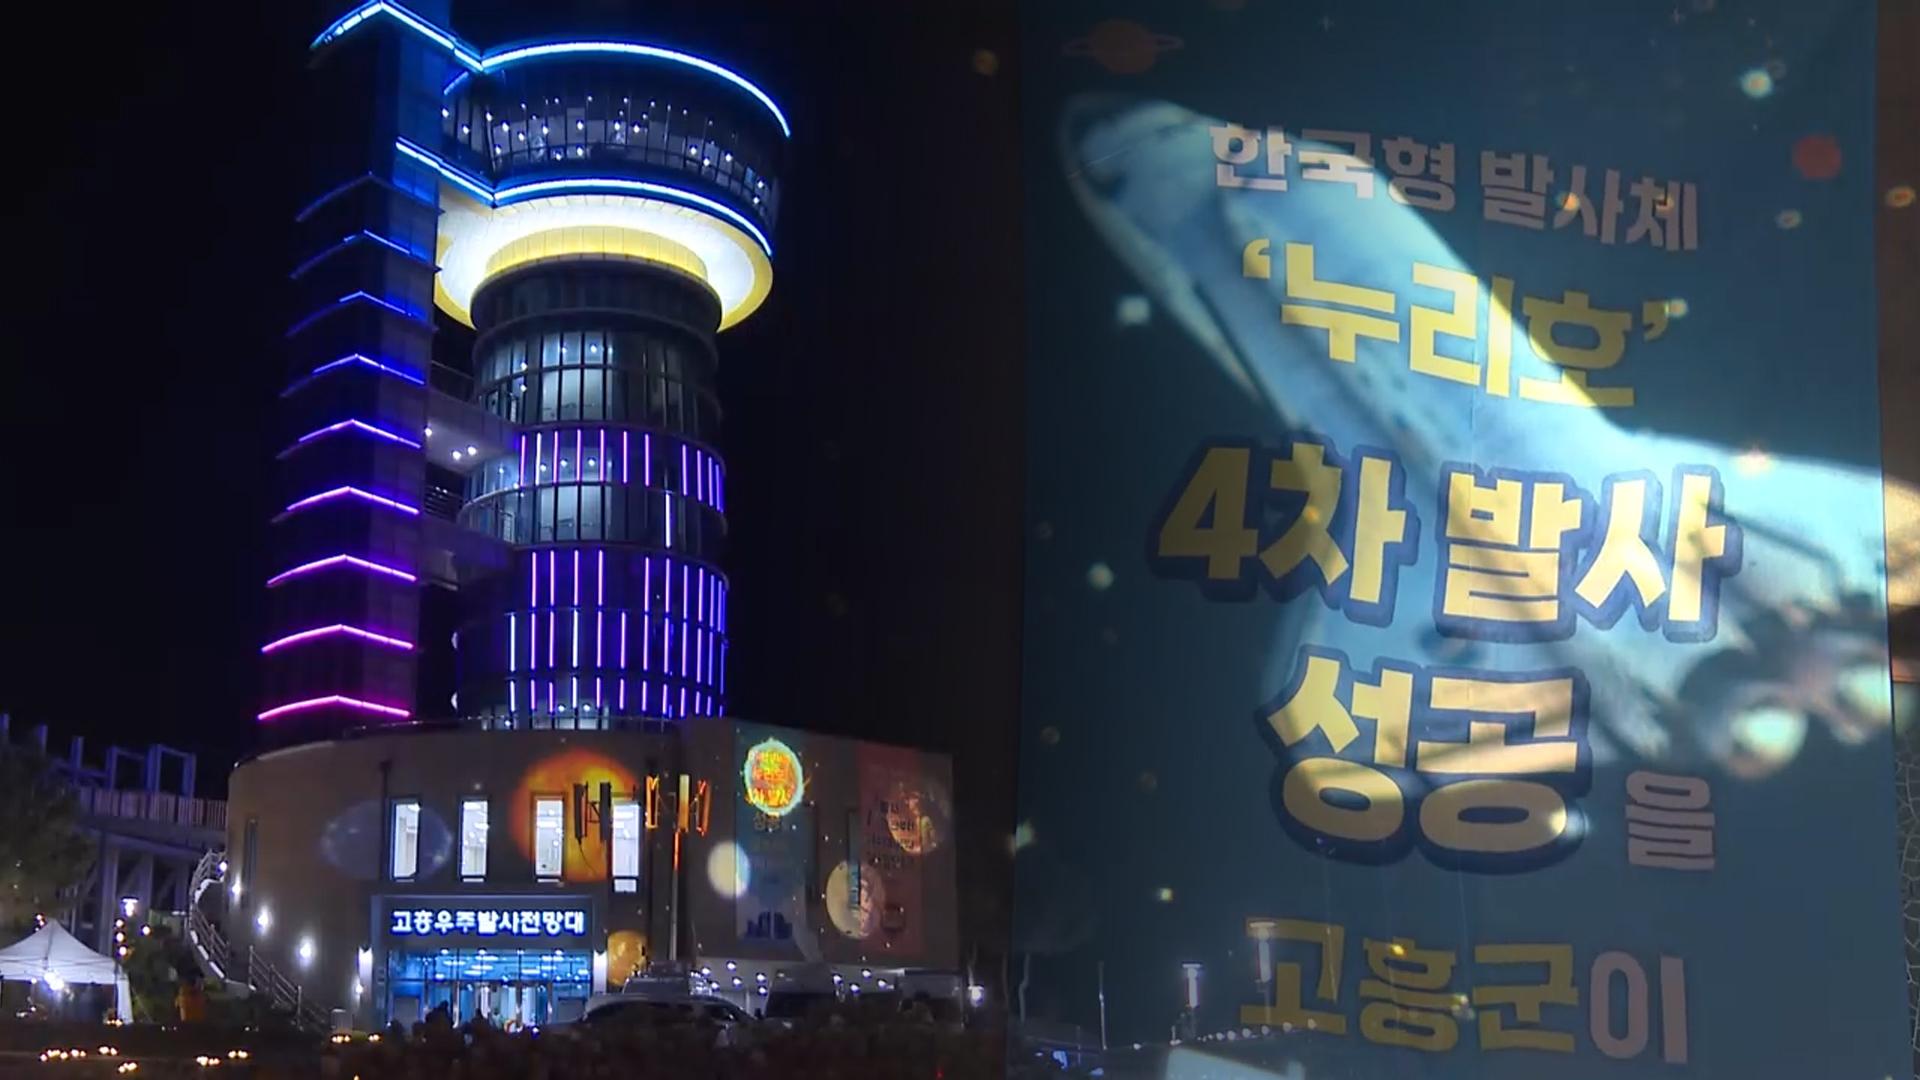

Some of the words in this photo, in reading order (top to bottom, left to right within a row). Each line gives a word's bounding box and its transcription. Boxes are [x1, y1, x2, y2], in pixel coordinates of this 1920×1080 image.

[1209, 122, 1457, 212] 한국형
[1480, 149, 1699, 253] 발사체
[1155, 440, 1407, 605] 4차
[1441, 470, 1727, 624] 발사
[390, 909, 586, 936] 고흥우주발사전망대
